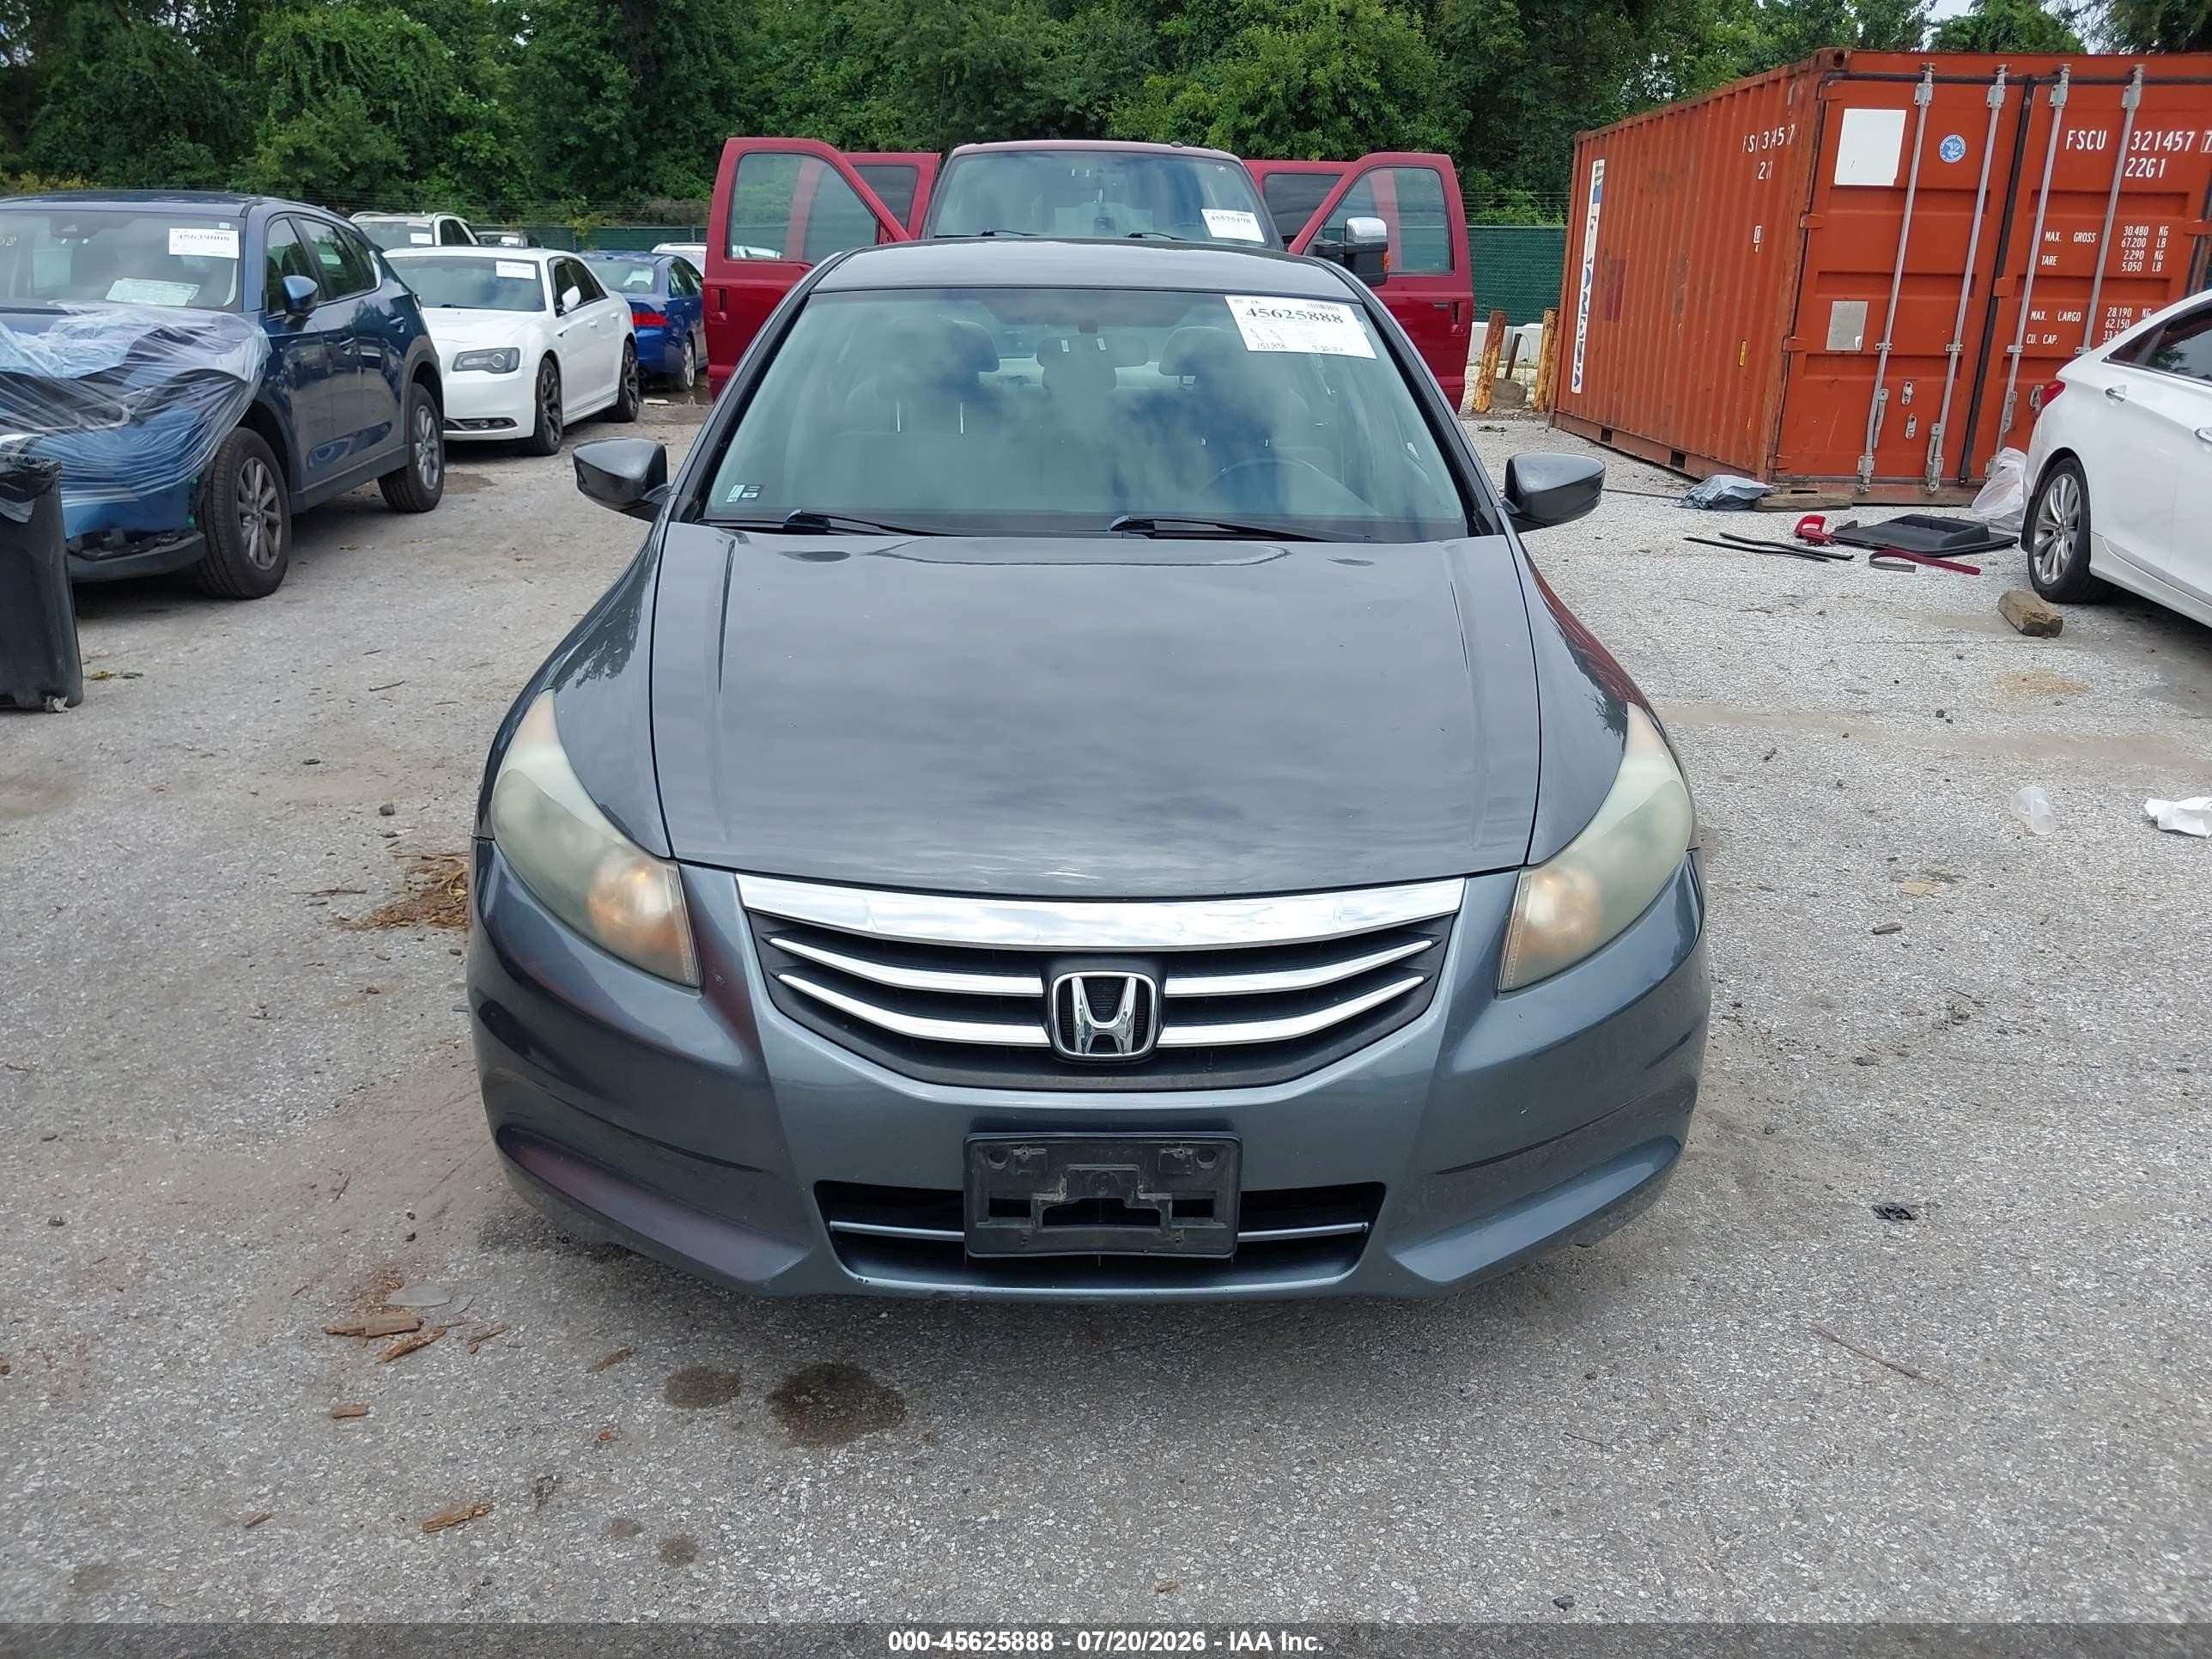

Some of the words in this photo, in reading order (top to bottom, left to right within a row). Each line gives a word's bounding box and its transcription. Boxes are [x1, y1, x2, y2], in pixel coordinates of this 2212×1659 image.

[2066, 130, 2107, 150] FSCU
[2130, 131, 2196, 151] 321457
[2124, 157, 2166, 178] 22G1
[2123, 226, 2149, 236] 30.480
[2159, 226, 2169, 236] KG
[2045, 231, 2062, 242] MAX.
[2073, 232, 2096, 243] GROSS
[2121, 237, 2147, 248] 67.200
[2156, 237, 2166, 248] LB
[2041, 255, 2058, 266] TARE
[2124, 250, 2145, 260] 2.290
[2154, 250, 2164, 261] KG
[2121, 261, 2142, 272] 5.050
[2151, 261, 2161, 272] LB
[1245, 307, 1344, 325] 45625888
[2030, 310, 2047, 321] MAX.
[2057, 310, 2081, 322] CARGO
[2106, 307, 2132, 318] 28.190
[2027, 333, 2038, 344] CU.
[2042, 334, 2058, 344] CAP.
